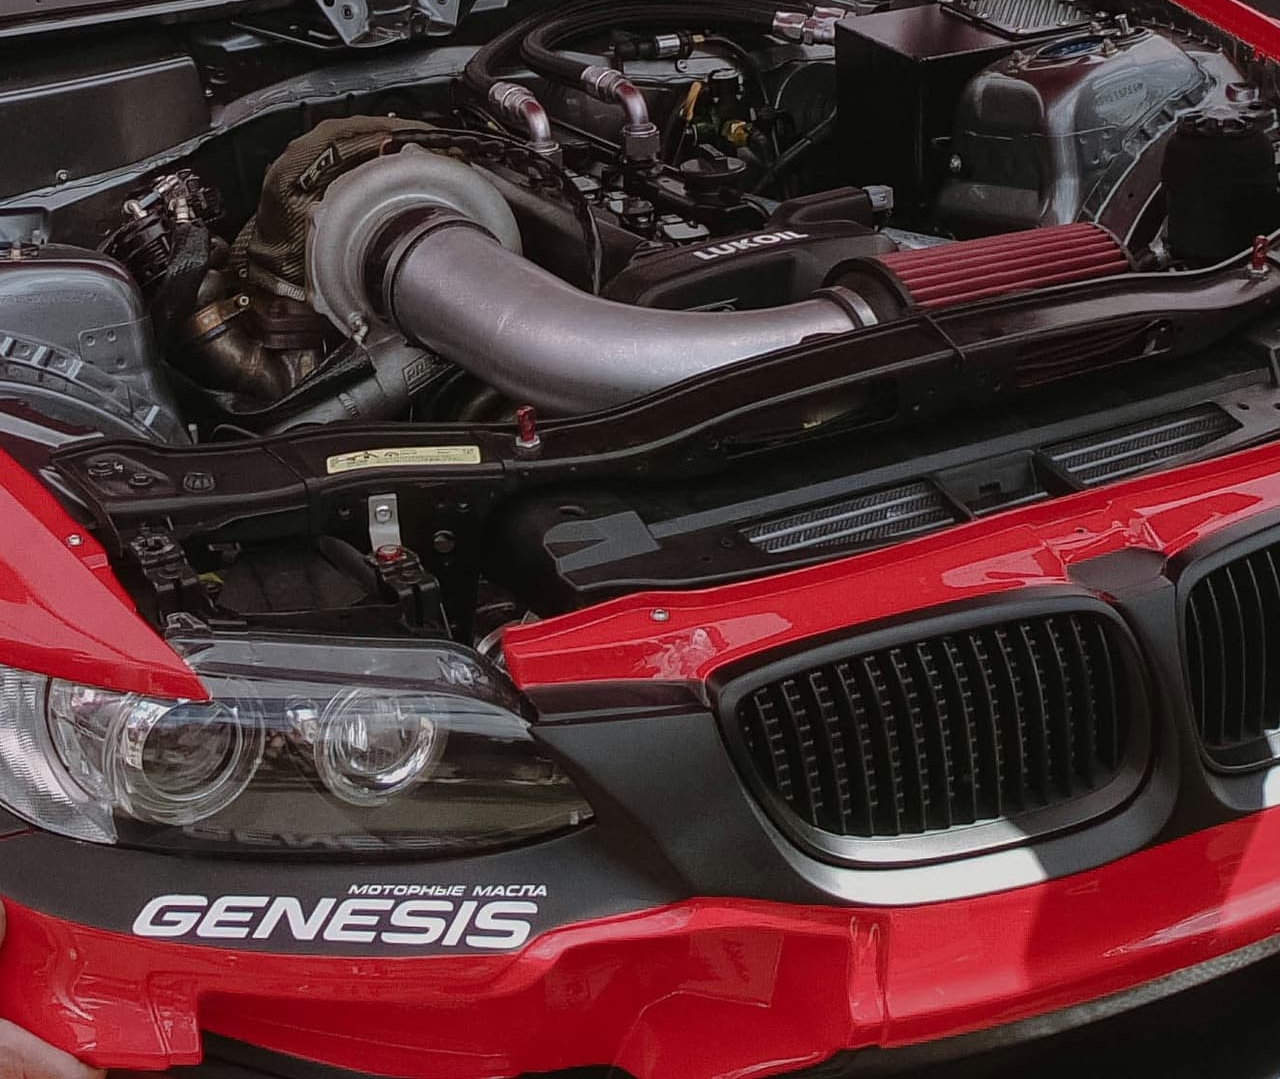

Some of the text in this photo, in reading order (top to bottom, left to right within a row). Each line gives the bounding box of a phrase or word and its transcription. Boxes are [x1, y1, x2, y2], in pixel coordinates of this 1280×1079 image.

[693, 231, 809, 260] LUKOIL
[348, 884, 548, 898] МОТОРНЫЕ МАСЛА
[132, 894, 539, 949] GENESIS
